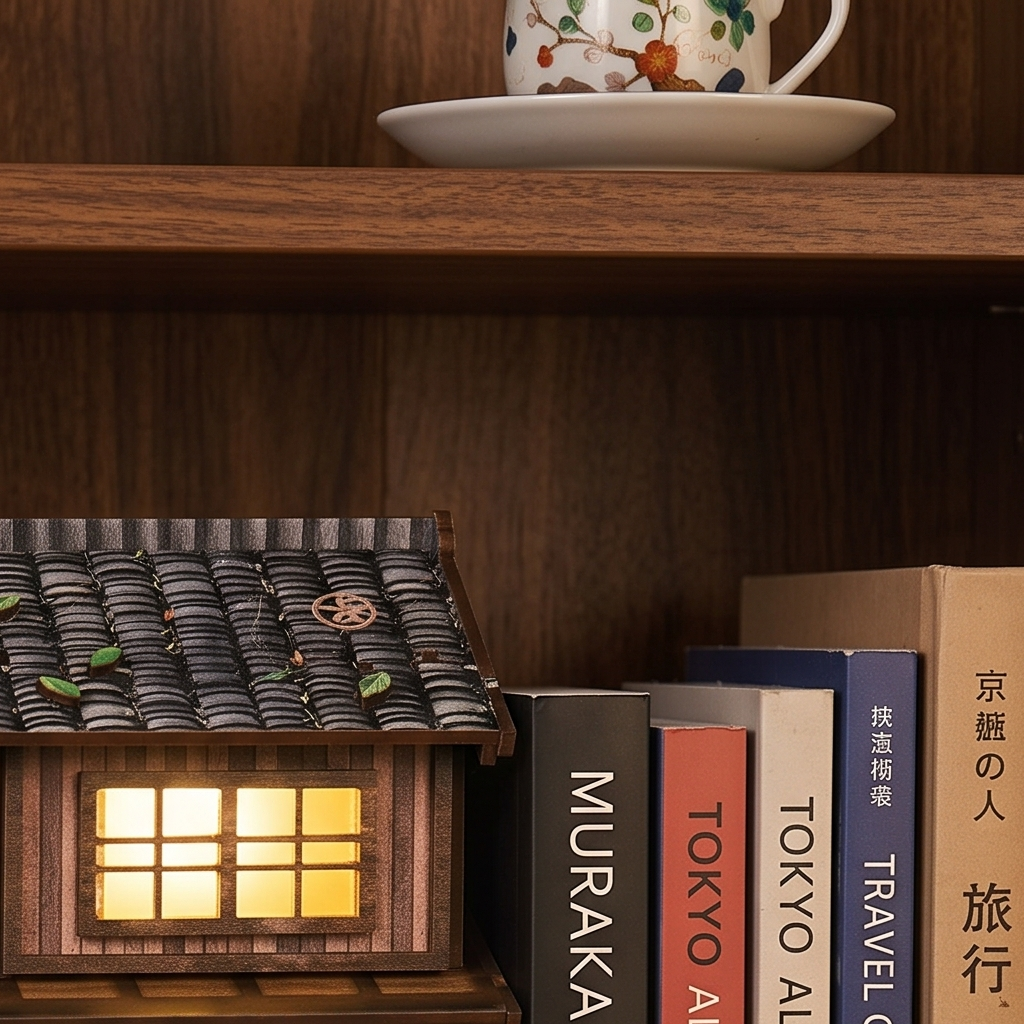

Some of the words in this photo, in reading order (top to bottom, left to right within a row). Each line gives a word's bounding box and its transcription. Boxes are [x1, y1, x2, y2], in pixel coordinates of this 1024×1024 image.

[687, 802, 722, 965] TOKYO
[779, 797, 814, 953] TOKYO
[864, 854, 895, 1001] TRAVEL
[962, 883, 1012, 993] 旅行
